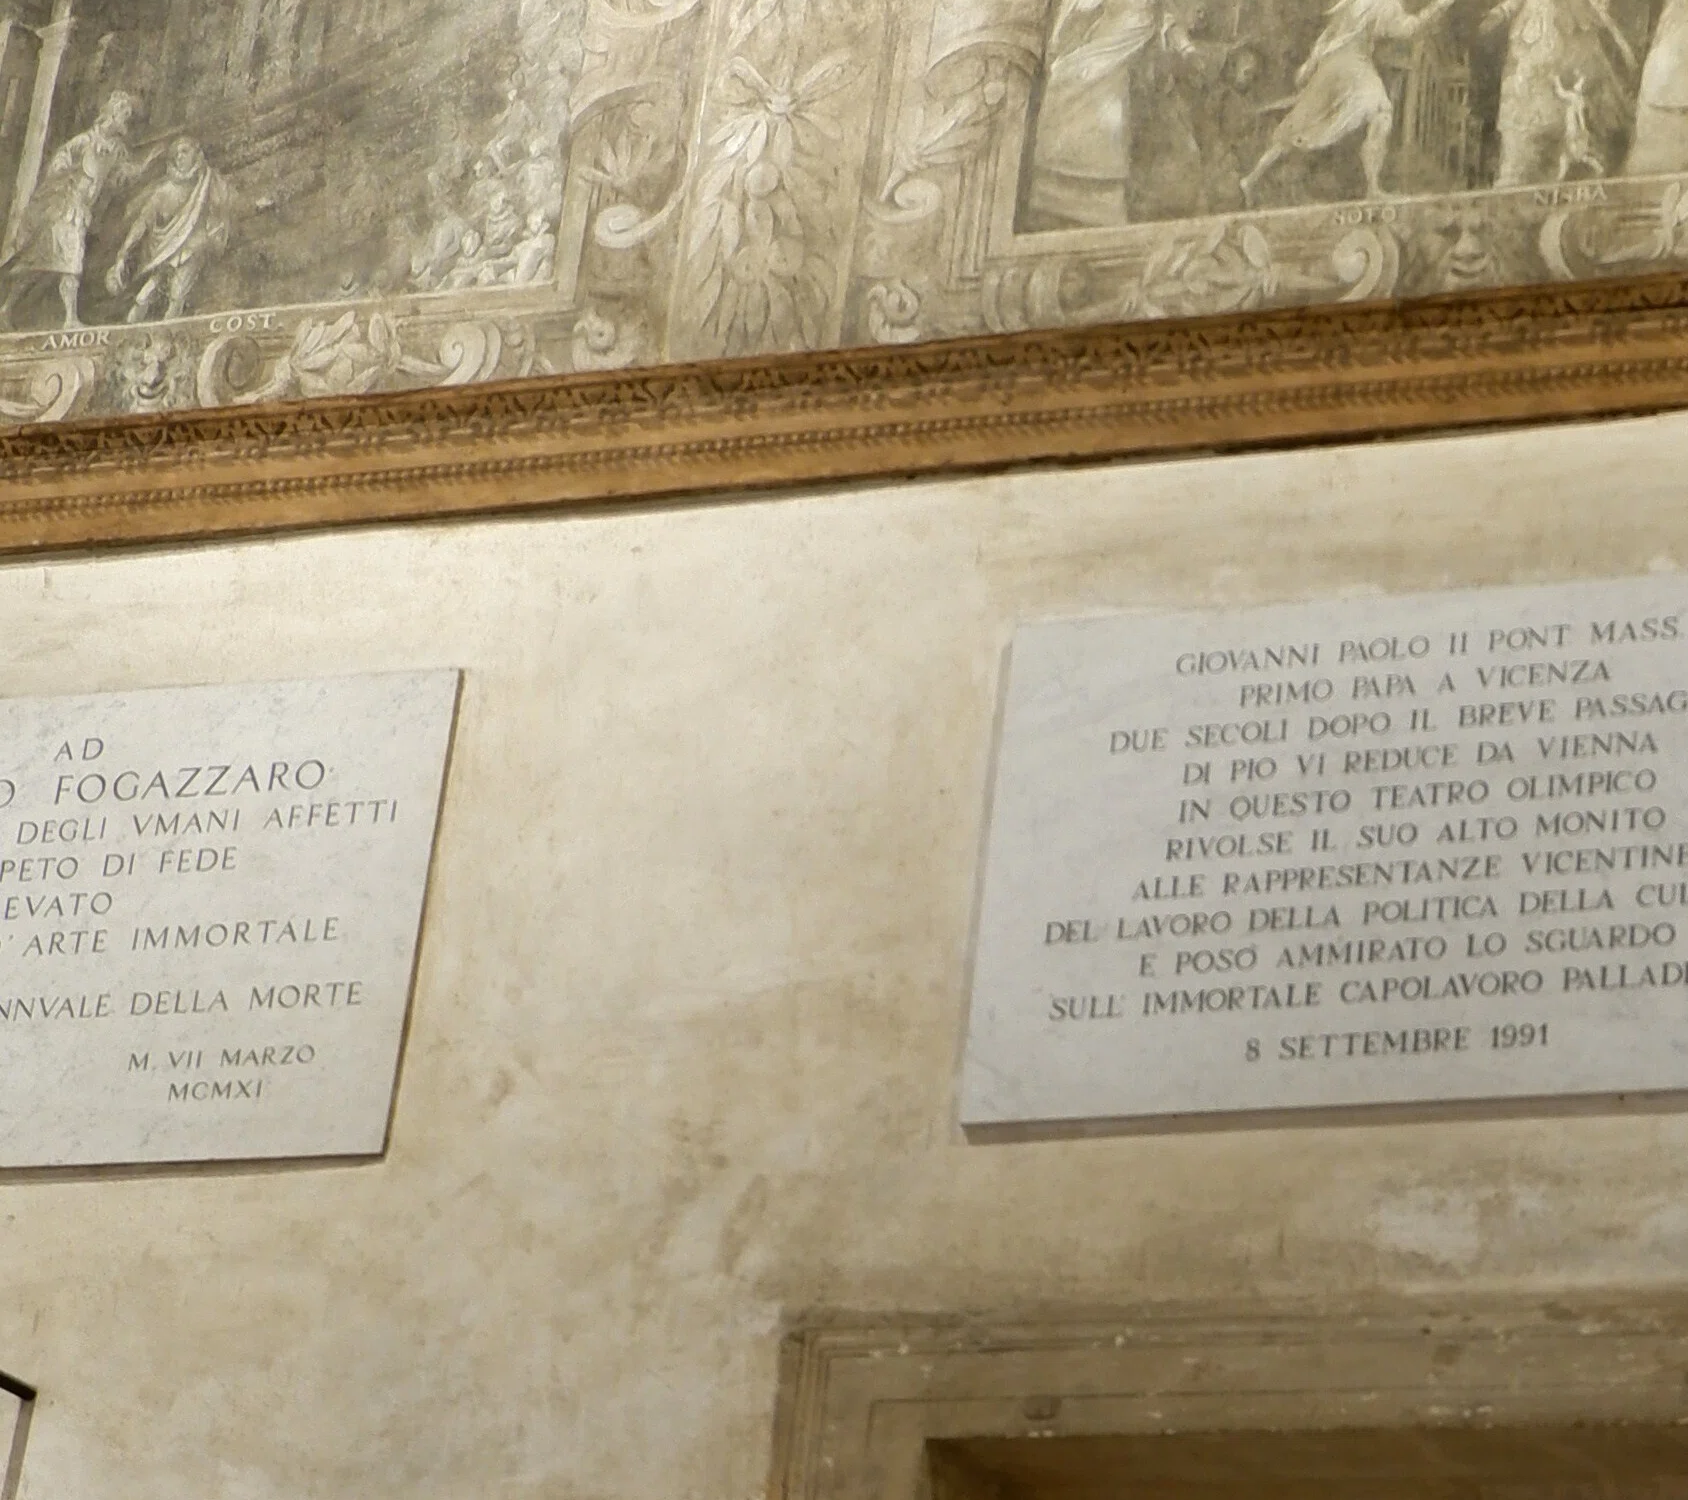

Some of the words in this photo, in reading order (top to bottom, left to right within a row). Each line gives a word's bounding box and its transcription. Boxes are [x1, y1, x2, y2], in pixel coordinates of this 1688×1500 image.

[1177, 644, 1318, 674] GIOVANNI
[1339, 637, 1429, 663] PAOLO
[1450, 633, 1466, 655] II
[1490, 625, 1570, 652] PONT
[1241, 680, 1333, 707] PRIMO
[1353, 675, 1415, 699] PAPA
[1439, 673, 1455, 692] A
[1478, 661, 1609, 687] VICENZA
[1111, 729, 1167, 754] DUE
[1186, 719, 1287, 747] SECOLI
[1309, 713, 1390, 740] DOPO
[1411, 709, 1434, 730] IL
[1460, 701, 1554, 727] BREVE
[55, 739, 103, 761] AD
[1184, 763, 1210, 785] DI
[1231, 758, 1276, 782] PIO
[1298, 754, 1323, 775] VI
[1345, 746, 1452, 773] REDUCE
[1478, 743, 1513, 765] DA
[1539, 732, 1657, 759] VIENNA
[55, 760, 326, 804] FOGAZZARO
[1180, 800, 1209, 823] IN
[1230, 791, 1350, 821] QUESTO
[1374, 781, 1488, 810] TEATRO
[1508, 770, 1656, 800] OLIMPICO
[17, 818, 106, 844] DEGLI
[134, 810, 238, 835] VMANI
[265, 800, 396, 827] AFFETTI
[1167, 832, 1291, 861] RIVOLSE
[1312, 830, 1334, 851] IL
[1358, 824, 1417, 847] SUO
[1438, 818, 1517, 842] ALTO
[1537, 808, 1665, 836] MONITO
[104, 854, 134, 876] DI
[160, 847, 235, 872] FEDE
[1134, 876, 1203, 899] ALLE
[1223, 856, 1500, 895] RAPPRESENTANZE
[133, 918, 337, 950] IMMORTALE
[1046, 921, 1096, 944] DEL
[1118, 912, 1231, 940] LAVORO
[1249, 907, 1340, 932] DELLA
[1364, 896, 1497, 925] POLITICA
[1520, 889, 1613, 915] DELLA
[1140, 955, 1155, 976] E
[1278, 938, 1446, 967] AMMIRATO
[1468, 934, 1506, 957] LO
[1526, 923, 1675, 952] SGUARDO
[131, 991, 227, 1015] DELLA
[250, 982, 360, 1009] MORTE
[1144, 983, 1320, 1015] IMMORTALE
[1340, 971, 1543, 1003] CAPOLAVORO
[170, 1052, 201, 1068] VII
[221, 1046, 314, 1066] MARZO
[1246, 1039, 1260, 1061] 8
[1280, 1028, 1469, 1058] SETTEMBRE
[1493, 1024, 1547, 1049] 1991
[169, 1081, 261, 1100] MCMXI
